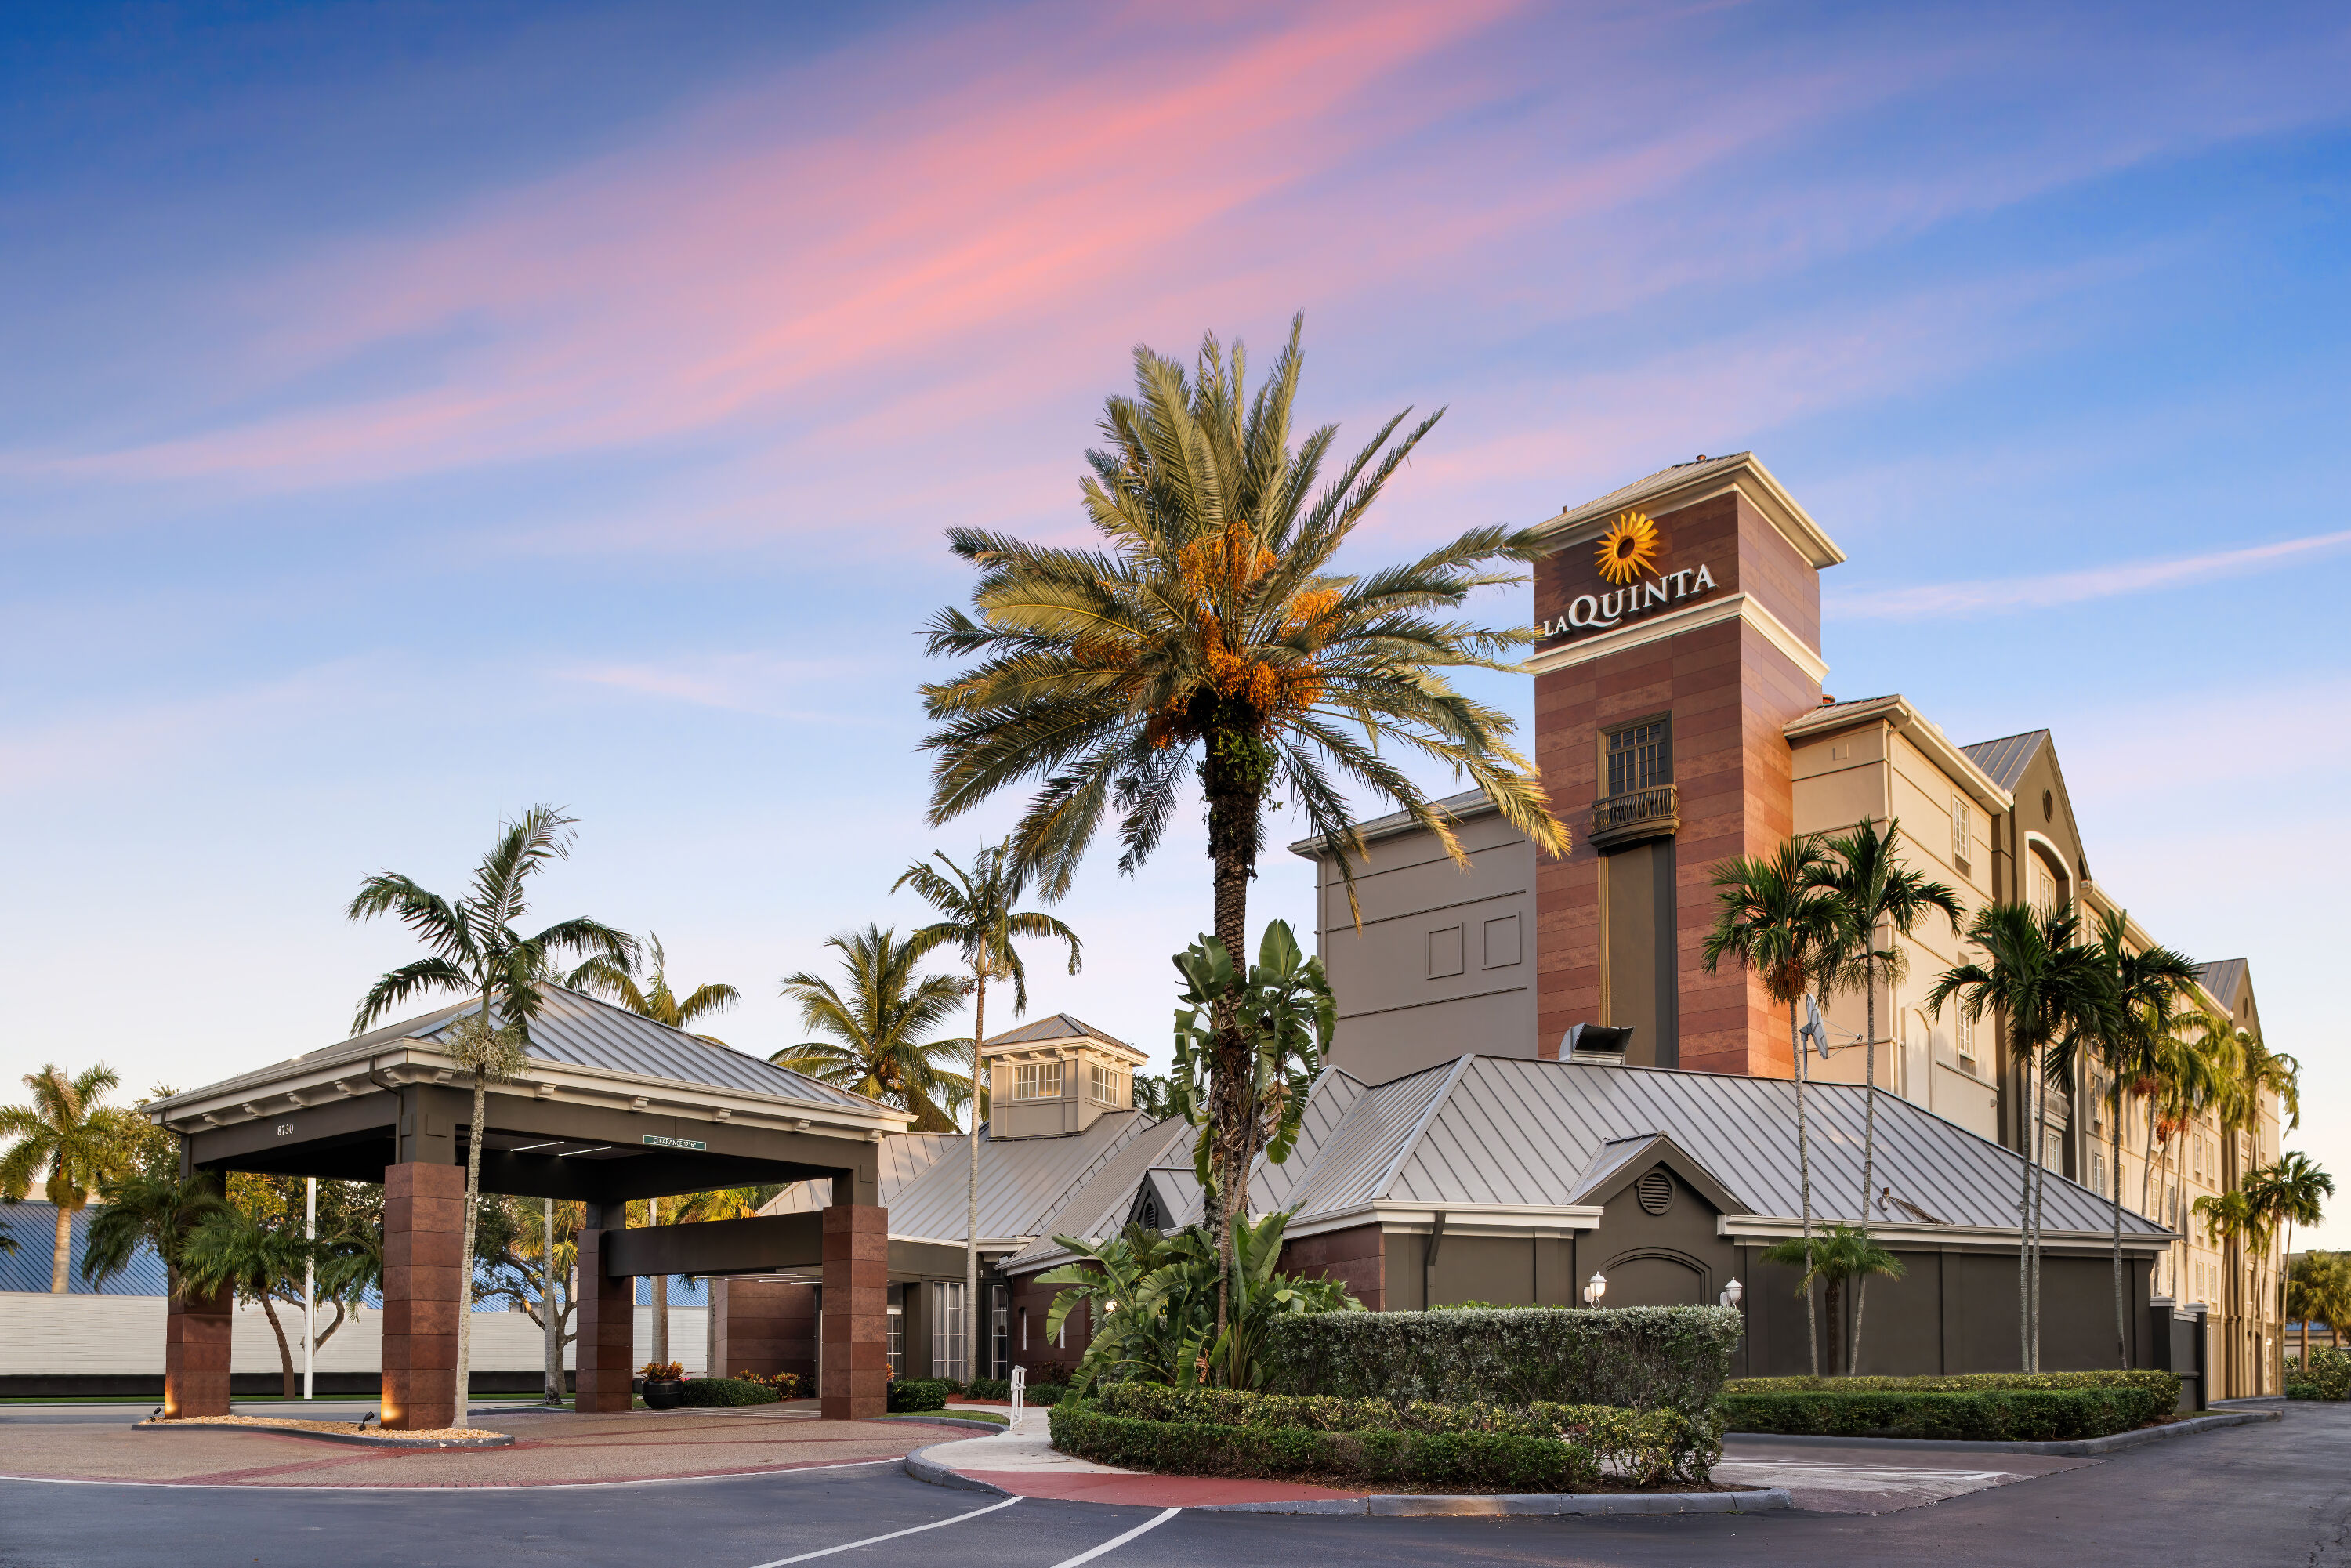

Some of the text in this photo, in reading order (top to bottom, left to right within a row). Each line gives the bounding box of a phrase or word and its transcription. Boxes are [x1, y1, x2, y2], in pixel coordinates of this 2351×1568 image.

[1543, 563, 1719, 637] LA QUINTA
[277, 1124, 294, 1135] 8730
[653, 1138, 683, 1146] CLEARANCE
